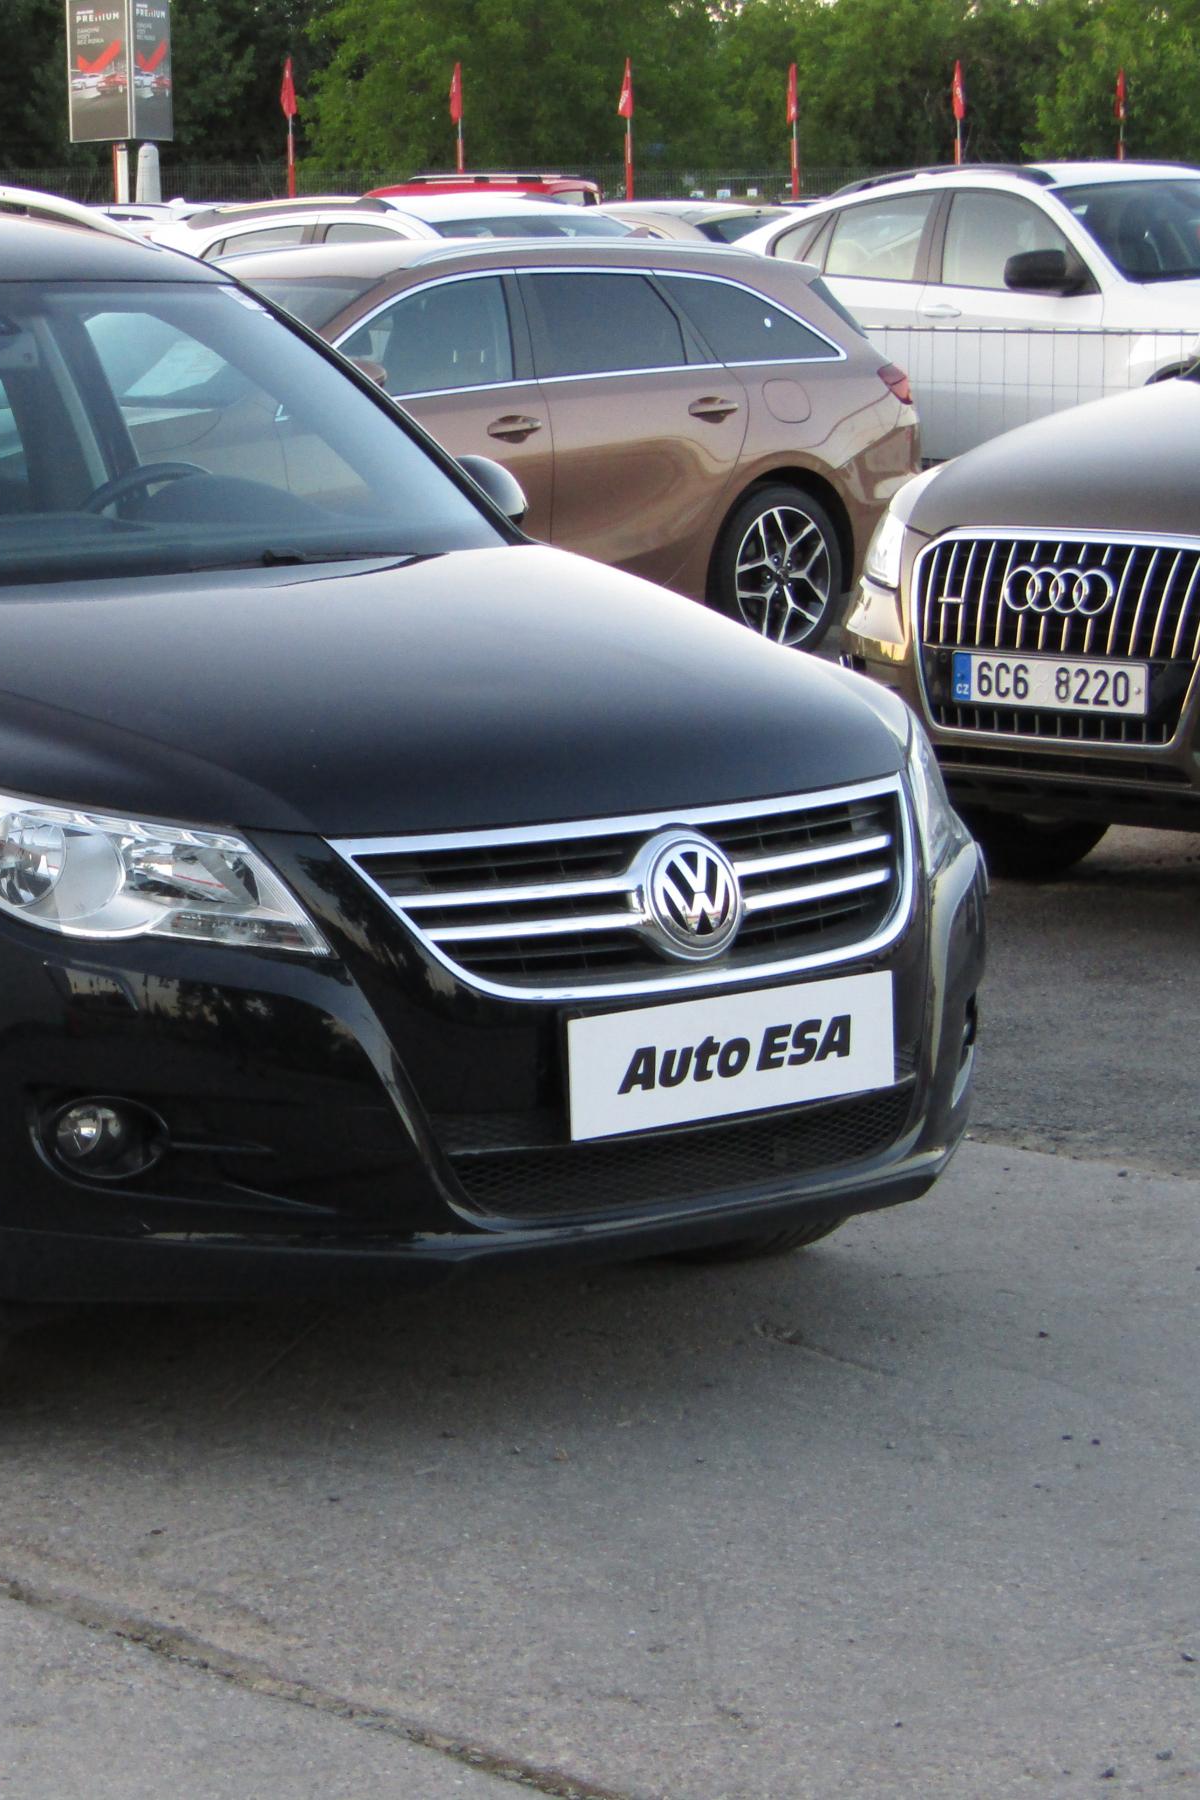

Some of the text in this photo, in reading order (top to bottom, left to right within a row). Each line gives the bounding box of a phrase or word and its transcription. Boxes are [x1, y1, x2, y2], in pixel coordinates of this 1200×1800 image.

[75, 11, 120, 23] PREMIUM
[956, 661, 1130, 707] CZ 6C6 8220
[617, 1013, 852, 1095] Auto ESA
